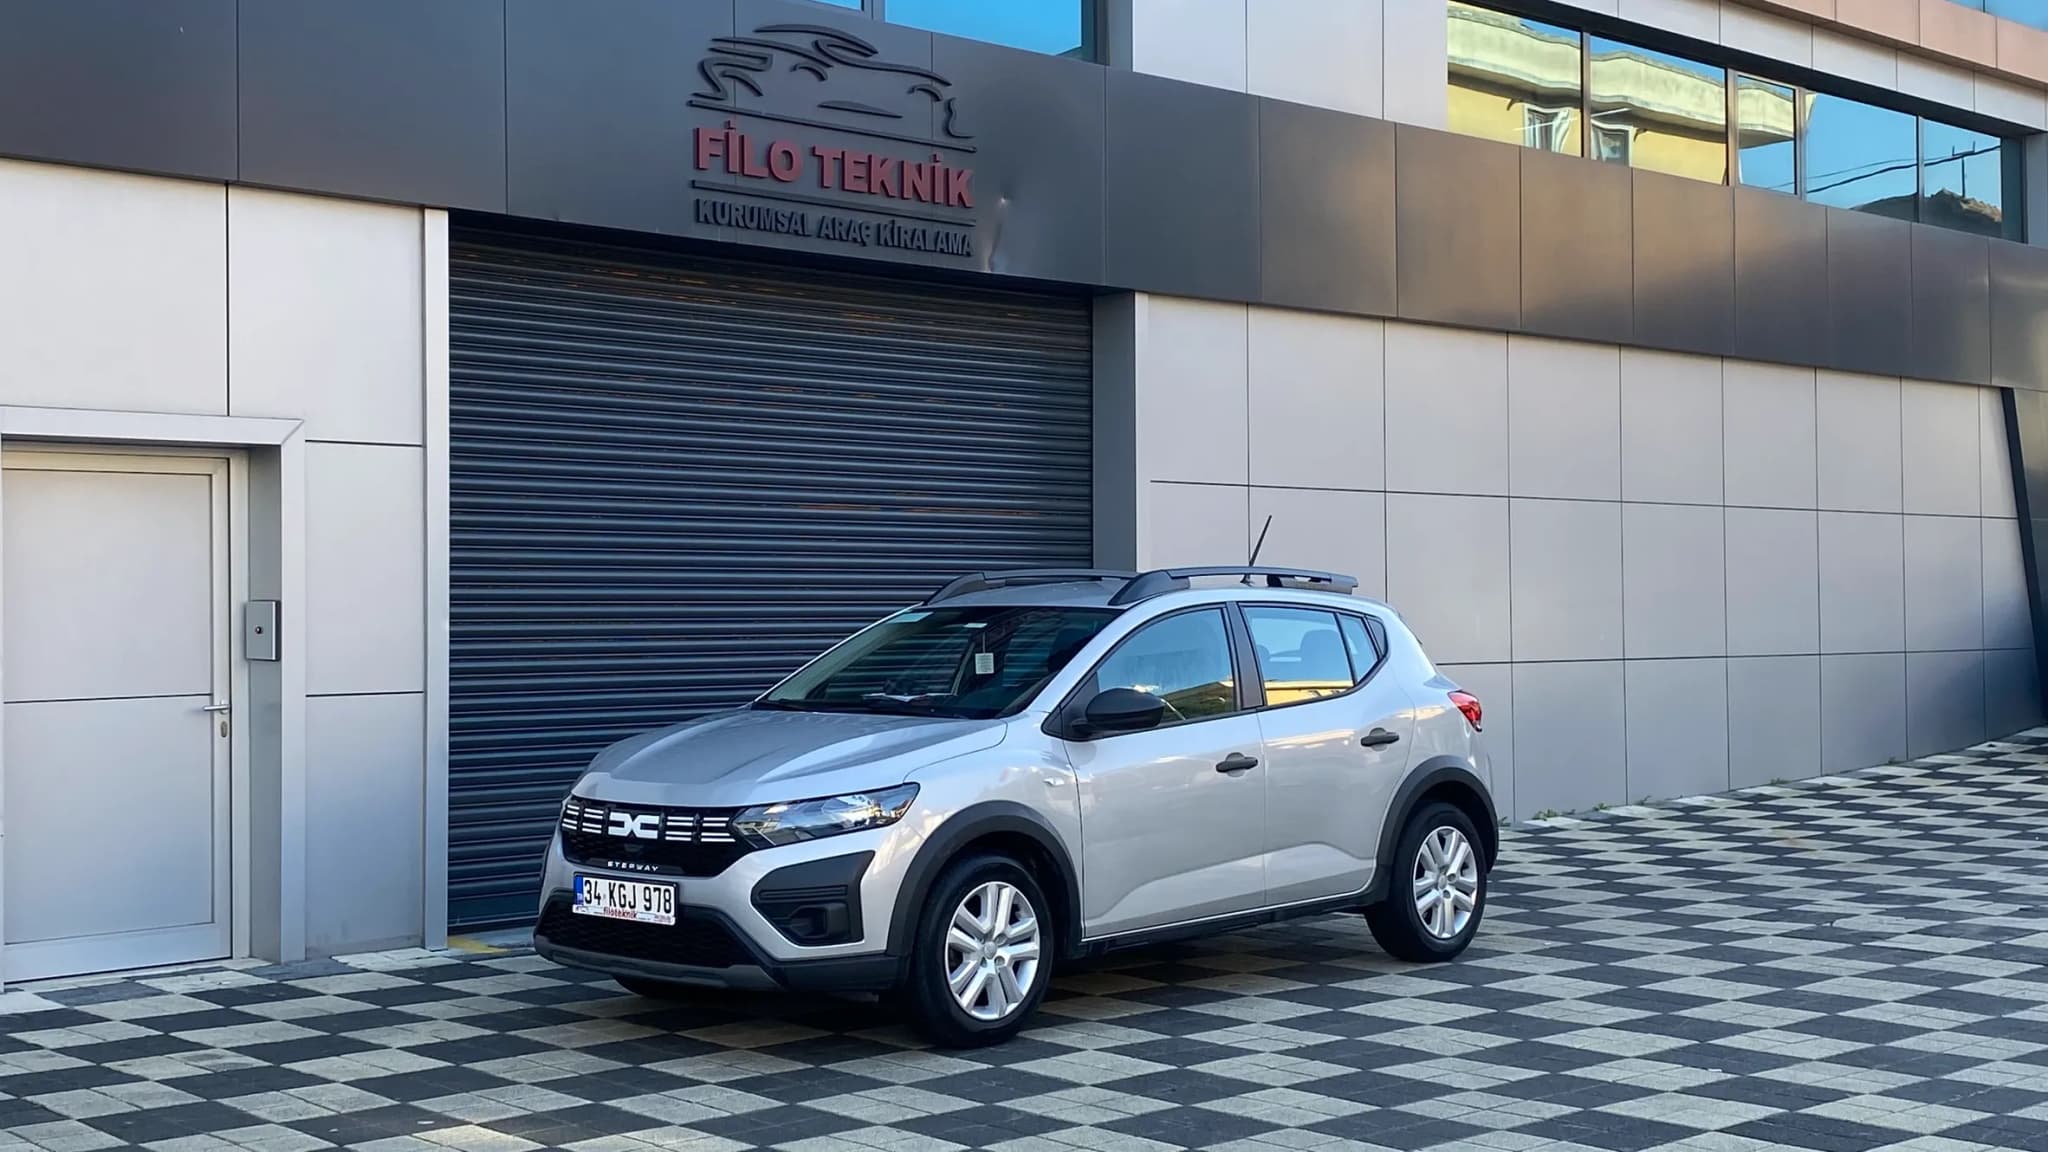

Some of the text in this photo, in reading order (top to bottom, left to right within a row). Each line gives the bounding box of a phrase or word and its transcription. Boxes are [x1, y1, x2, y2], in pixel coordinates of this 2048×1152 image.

[693, 120, 975, 208] FİLO TEKNİK
[695, 199, 974, 257] KURUMSAL ARAÇ KİRALAMA
[607, 861, 659, 872] STEPWAY
[584, 879, 672, 914] 34 KGJ 978
